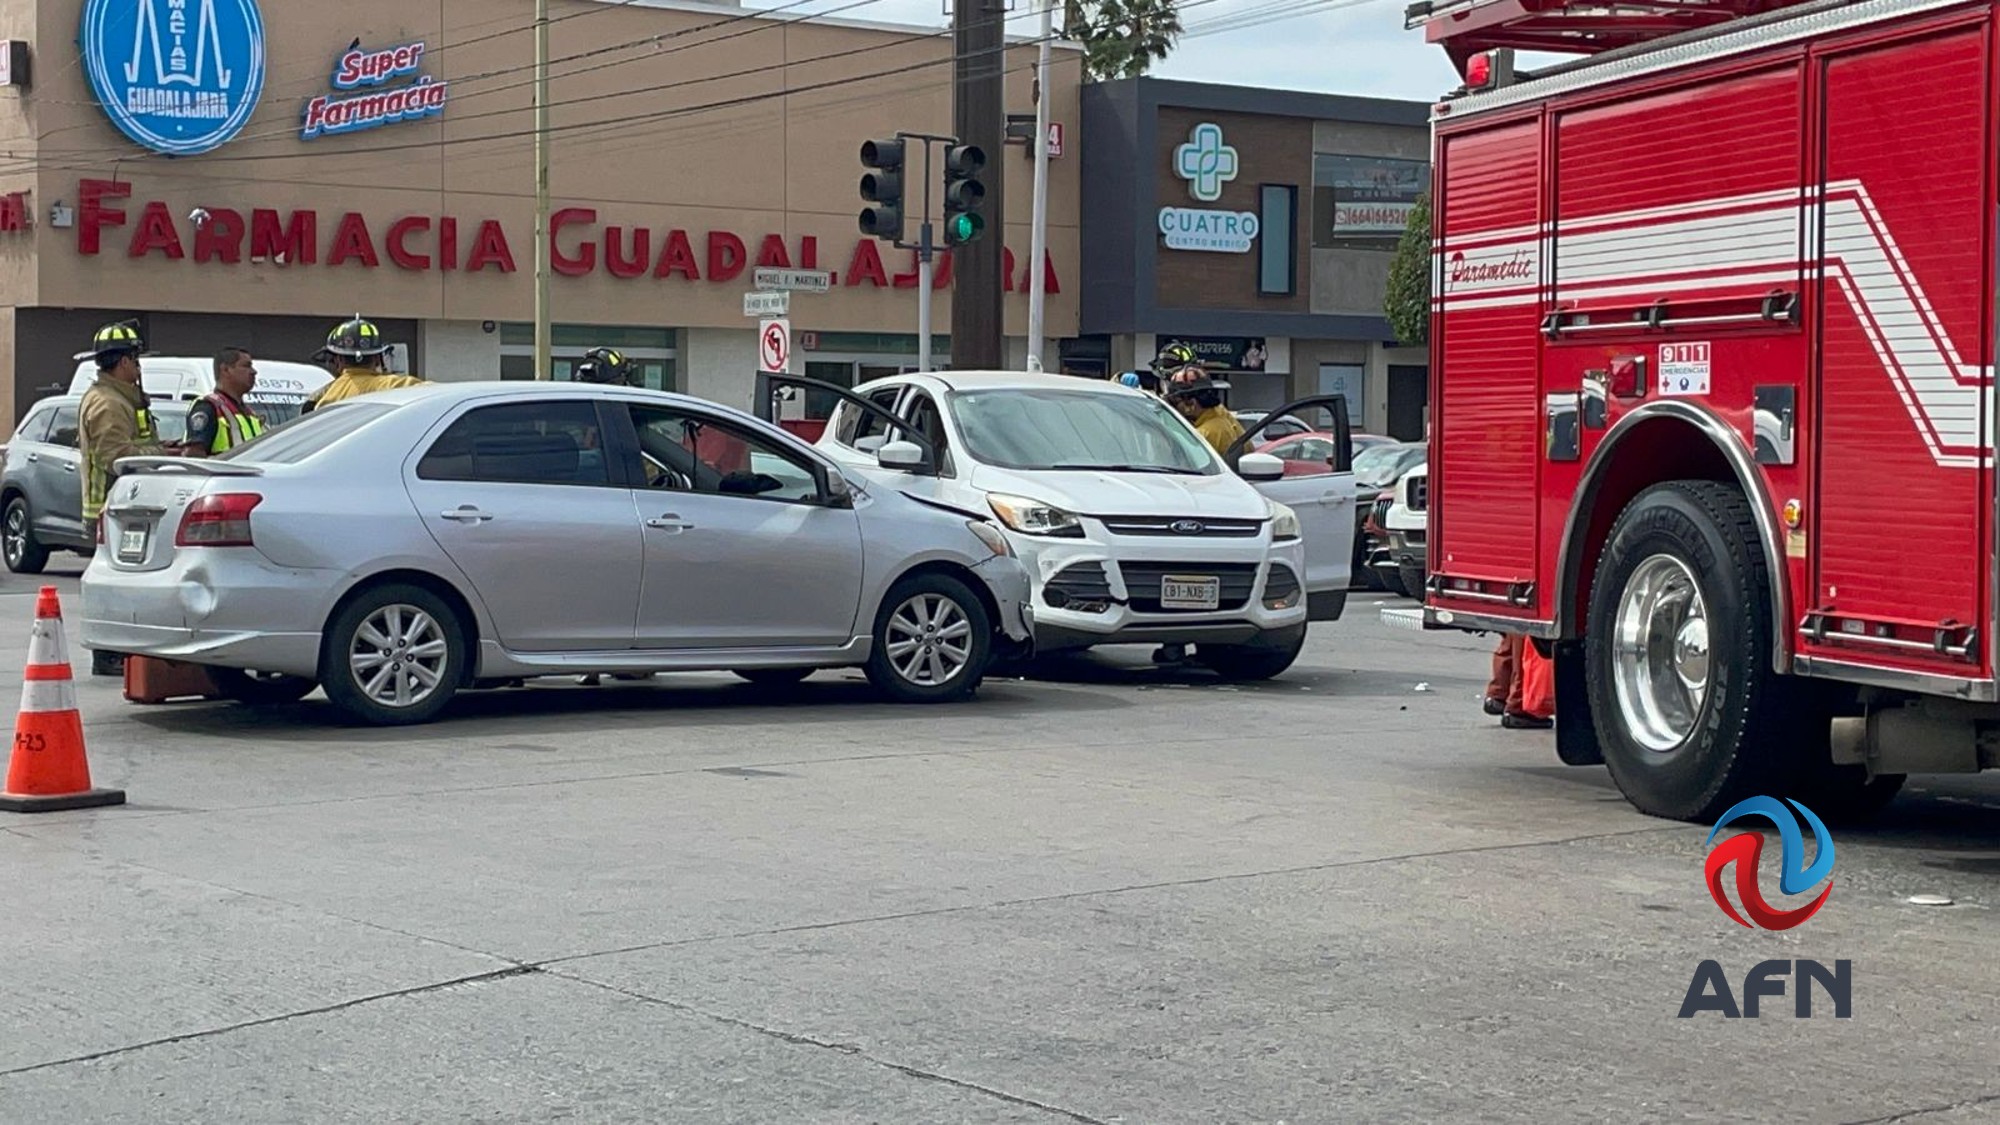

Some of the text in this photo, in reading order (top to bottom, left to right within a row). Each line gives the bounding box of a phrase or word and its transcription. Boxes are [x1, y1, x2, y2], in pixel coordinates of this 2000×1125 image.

[337, 43, 425, 85] Super
[127, 87, 229, 118] GUADALAJARA
[305, 76, 448, 133] Farmacia
[78, 178, 517, 272] FARMACIA
[1162, 212, 1256, 235] CUATRO
[1169, 237, 1207, 246] CENTRO
[794, 275, 827, 287] MARTINEZ
[1450, 249, 1532, 292] Paramedic
[1662, 345, 1705, 362] 911
[1660, 367, 1708, 375] EMERGENCIAS
